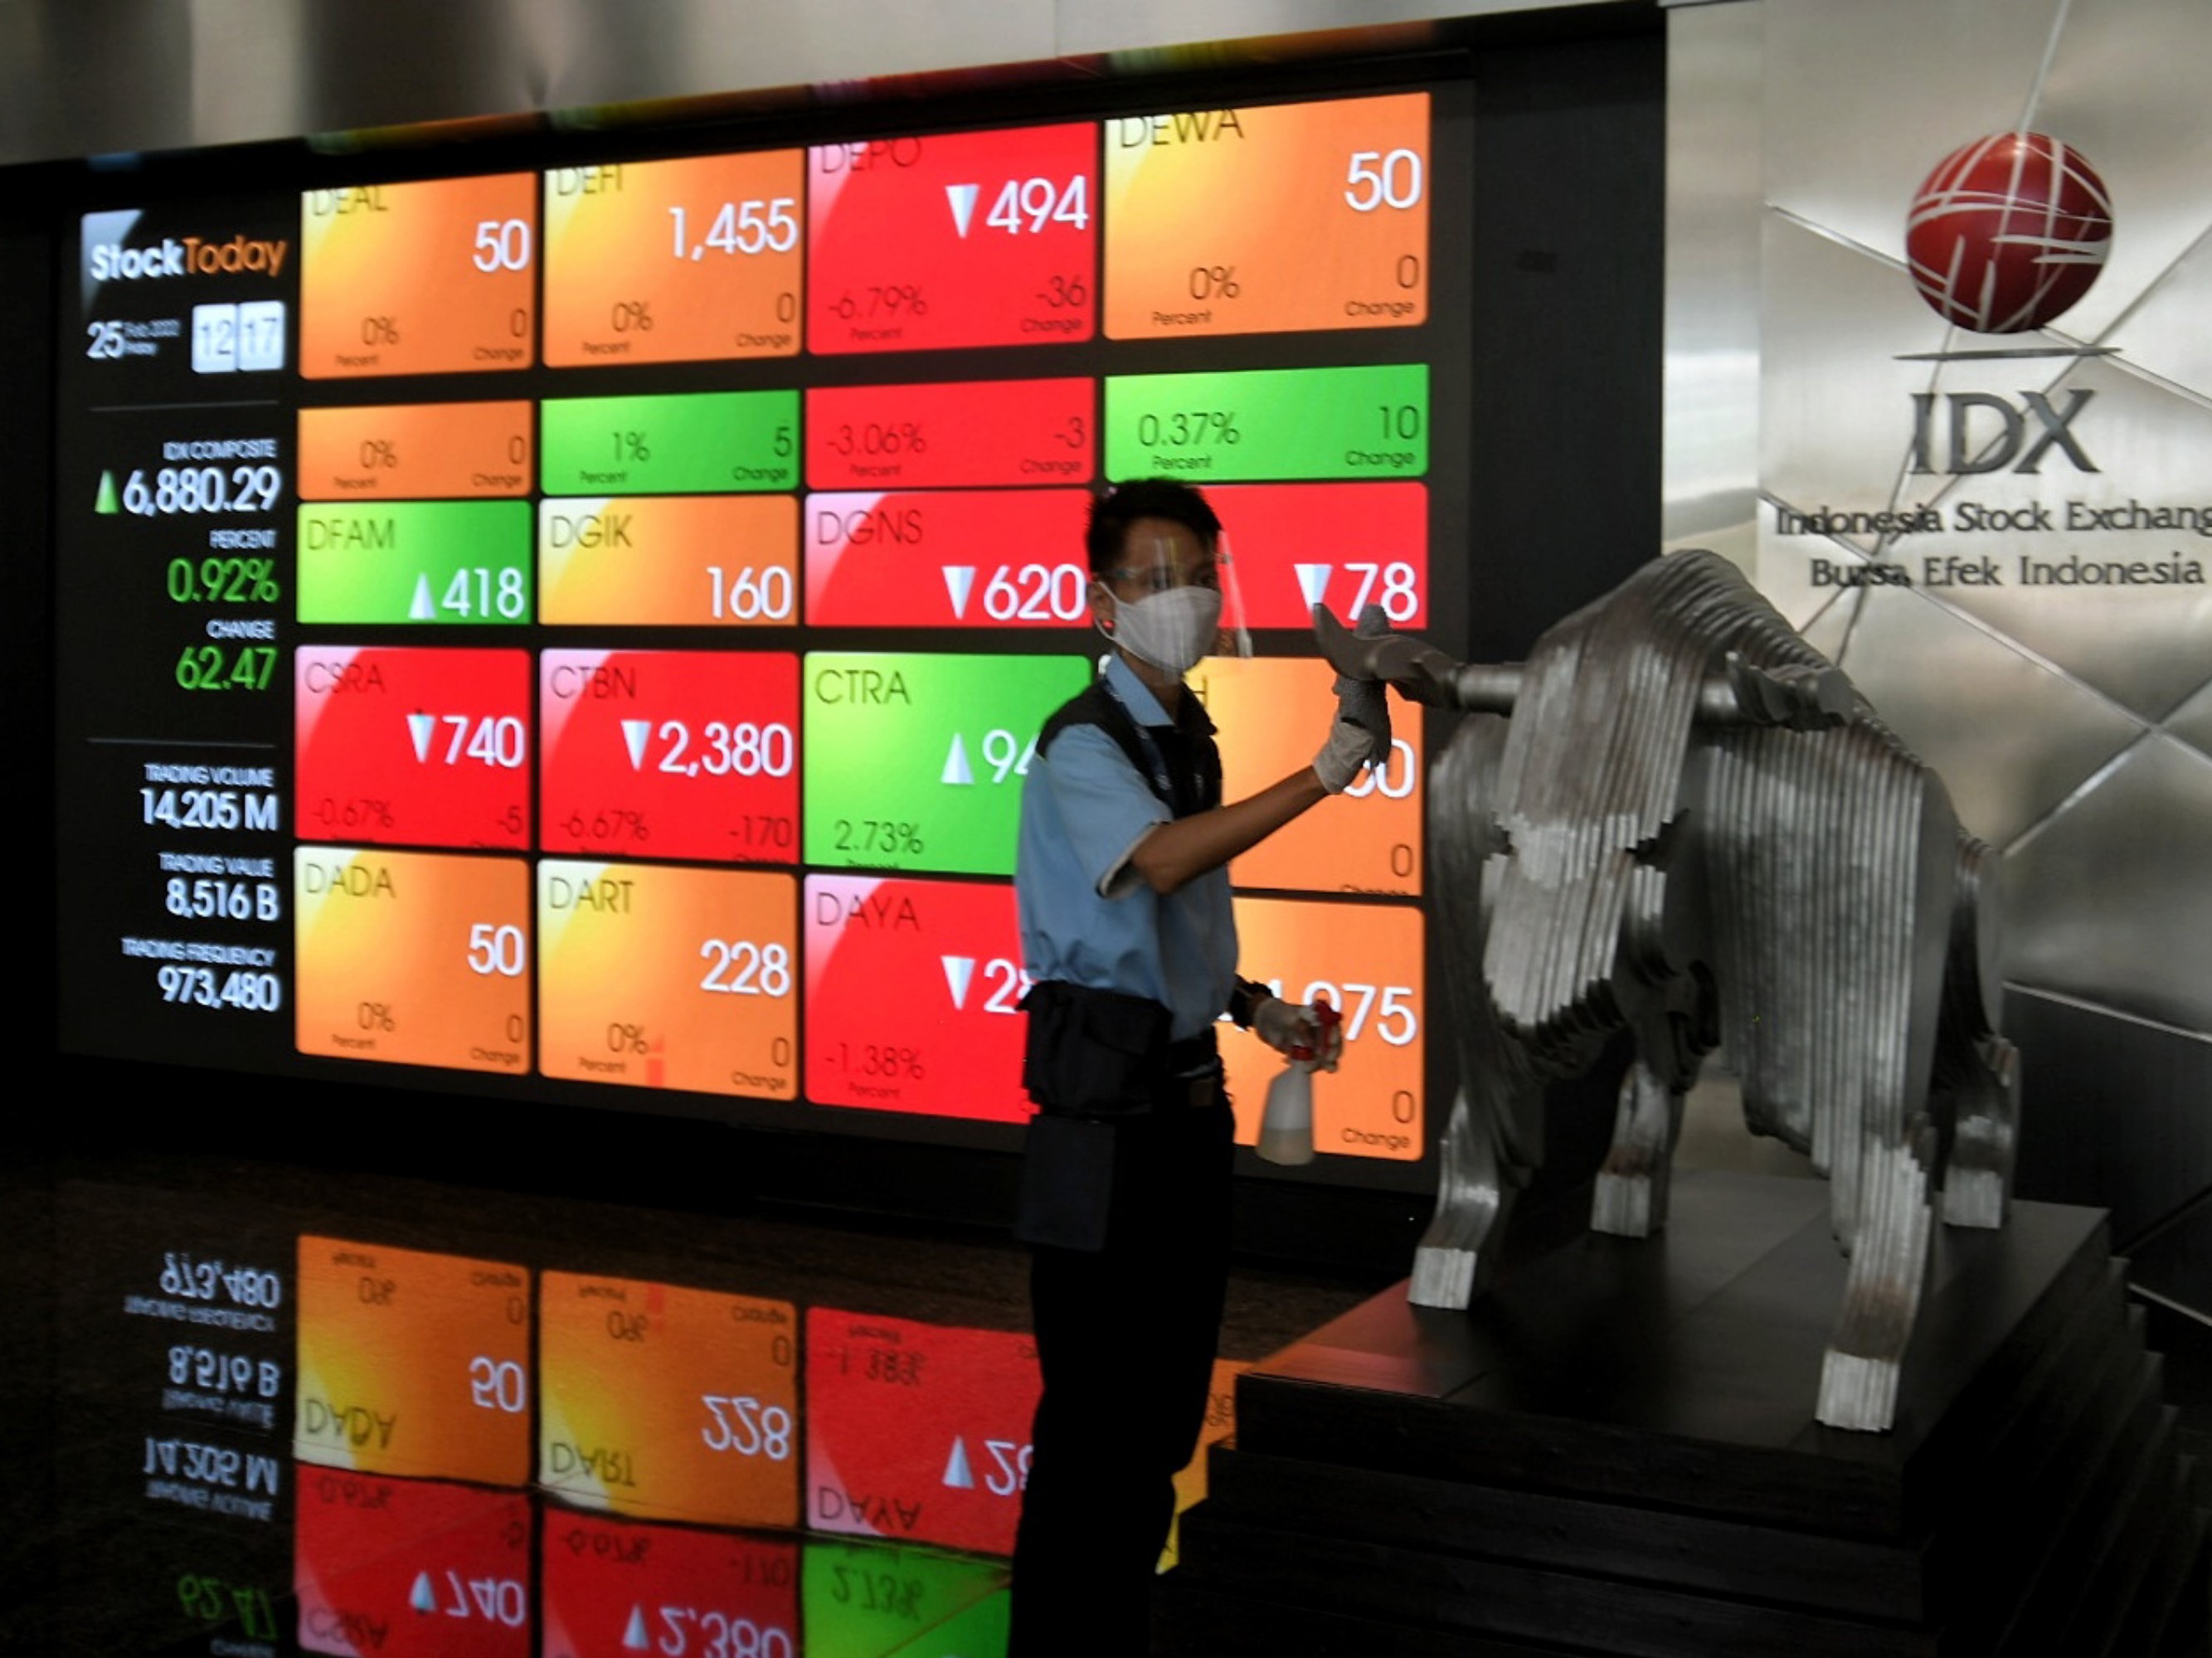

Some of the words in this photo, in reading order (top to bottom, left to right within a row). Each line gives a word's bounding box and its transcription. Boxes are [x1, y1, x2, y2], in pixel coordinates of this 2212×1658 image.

[1120, 108, 1244, 148] DEWA
[821, 137, 921, 174] DEPO
[557, 163, 622, 196] DEFI
[1344, 148, 1422, 212] 50
[313, 186, 389, 216] DEAL
[986, 173, 1089, 236] 494
[472, 218, 531, 272] 50
[668, 197, 799, 261] 1,455
[1189, 265, 1242, 301] 0%
[1396, 255, 1420, 289] 0
[775, 291, 795, 323] 0
[828, 284, 928, 320] -6.79%
[1034, 275, 1087, 309] -36
[1344, 300, 1415, 318] Change
[362, 315, 400, 346] 0%
[510, 308, 527, 338] 0
[611, 300, 654, 333] 0%
[1020, 318, 1083, 335] Change
[1150, 309, 1213, 327] Percent
[86, 322, 124, 358] 25
[201, 319, 233, 355] 12
[245, 316, 280, 355] 17
[826, 422, 927, 457] -3.06%
[1053, 416, 1086, 450] -3
[1138, 411, 1242, 448] 0.37%
[1378, 405, 1421, 441] 10
[1908, 389, 2101, 475] IDX
[360, 439, 398, 469] 0%
[508, 435, 527, 465] 0
[613, 431, 652, 462] 1%
[772, 425, 794, 458] 5
[1019, 459, 1082, 475] Change
[1151, 455, 1213, 469] Percent
[1344, 450, 1416, 469] Change
[123, 466, 282, 518] 6,880.29
[306, 518, 396, 551] DFAM
[549, 514, 634, 548] DGIK
[816, 509, 924, 546] DGNS
[1777, 503, 1945, 535] Indonesia
[1955, 501, 2054, 532] Stock
[168, 557, 280, 603] 0.92%
[1810, 557, 1913, 587] Bursa
[1923, 555, 2003, 586] Efek
[2020, 551, 2205, 586] Indonesia
[441, 566, 525, 619] 418
[706, 565, 794, 620] 160
[983, 563, 1087, 621] 620
[1343, 561, 1419, 622] 78
[175, 646, 278, 690] 62.47
[304, 662, 386, 694] CSRA
[550, 665, 636, 699] CTBN
[814, 669, 912, 705] CTRA
[441, 715, 526, 768] 740
[658, 720, 794, 778] 2,380
[245, 793, 279, 831] M
[497, 805, 524, 834] -5
[728, 814, 793, 848] -170
[833, 819, 925, 854] 2.73%
[1391, 844, 1413, 878] 0
[304, 863, 396, 898] DADA
[549, 876, 634, 913] DART
[256, 882, 280, 922] B
[816, 892, 921, 931] DAYA
[467, 922, 525, 976] 50
[700, 938, 791, 998] 228
[357, 1001, 396, 1033] 0%
[506, 1014, 524, 1043] 0
[606, 1023, 649, 1055] 0%
[771, 1037, 790, 1067] 0
[825, 1043, 925, 1081] -1.38%
[1393, 1089, 1415, 1124] 0
[1341, 1127, 1411, 1151] Change
